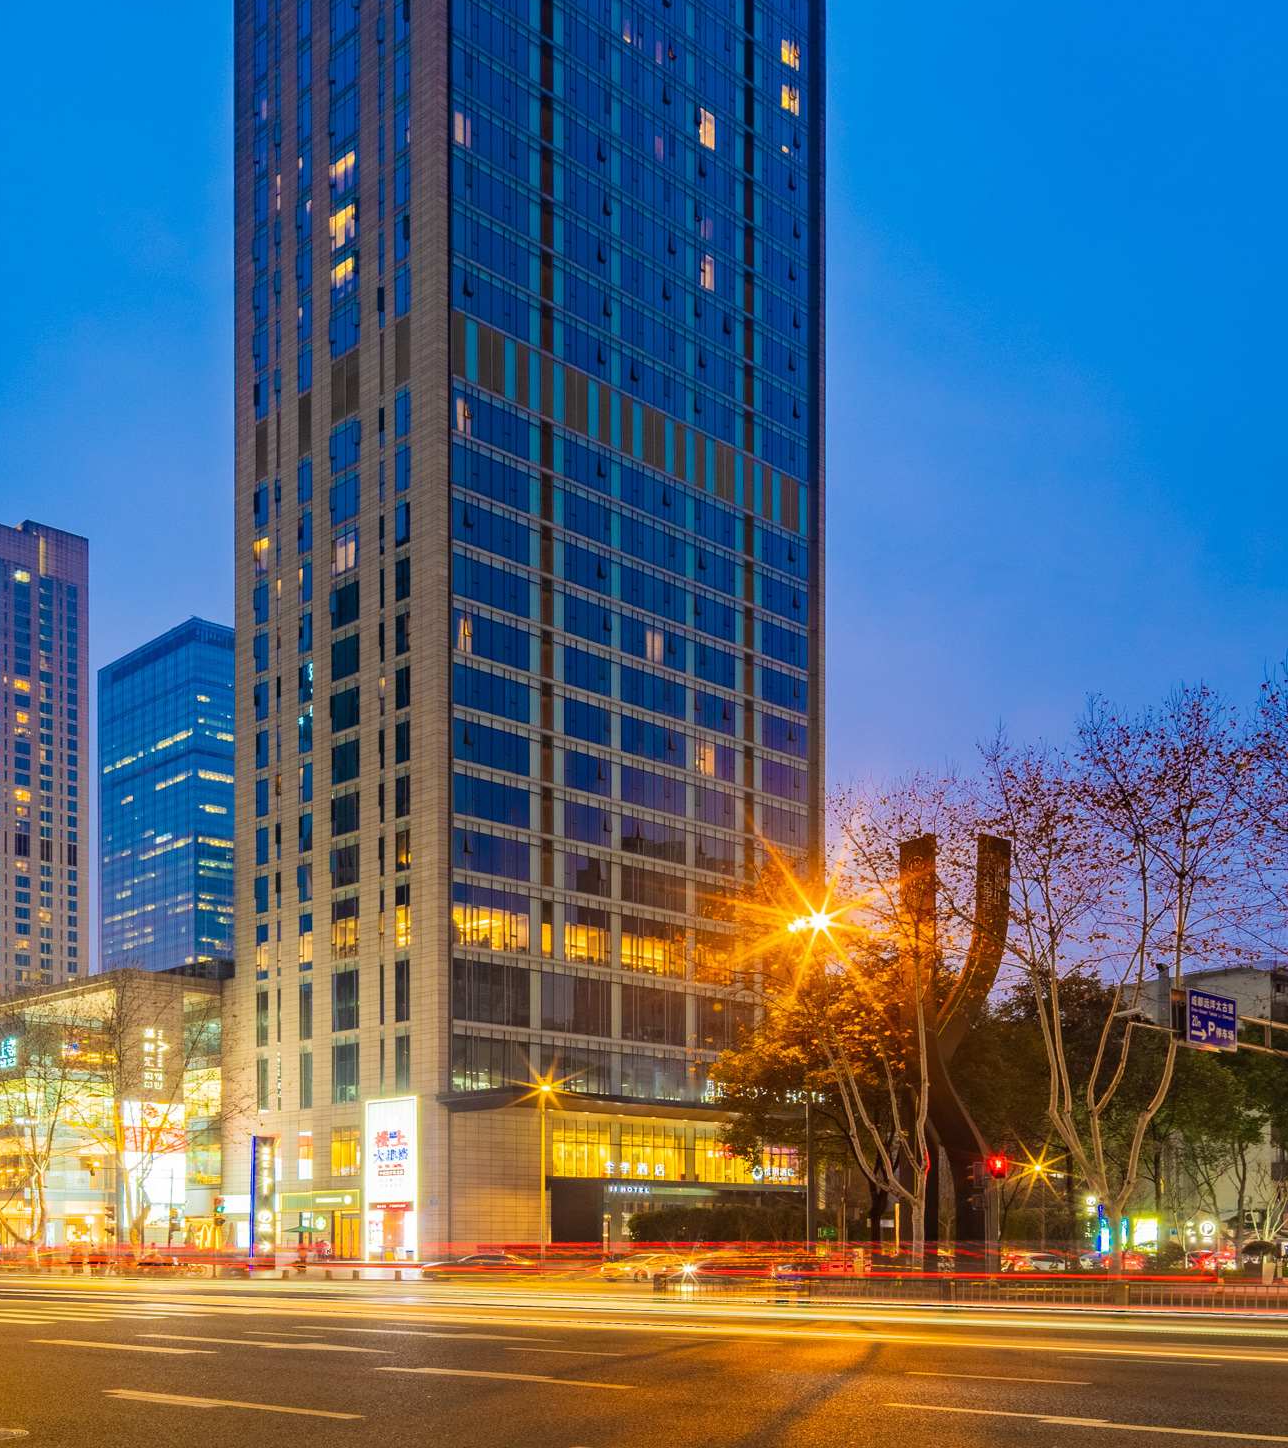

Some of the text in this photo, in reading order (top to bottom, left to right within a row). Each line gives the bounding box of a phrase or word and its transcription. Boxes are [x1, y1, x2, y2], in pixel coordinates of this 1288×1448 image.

[1191, 995, 1234, 1015] 成都远洋太古里
[1208, 1021, 1234, 1041] P 停车场
[603, 1160, 665, 1177] 全季酒店
[620, 1185, 651, 1194] HOTEL
